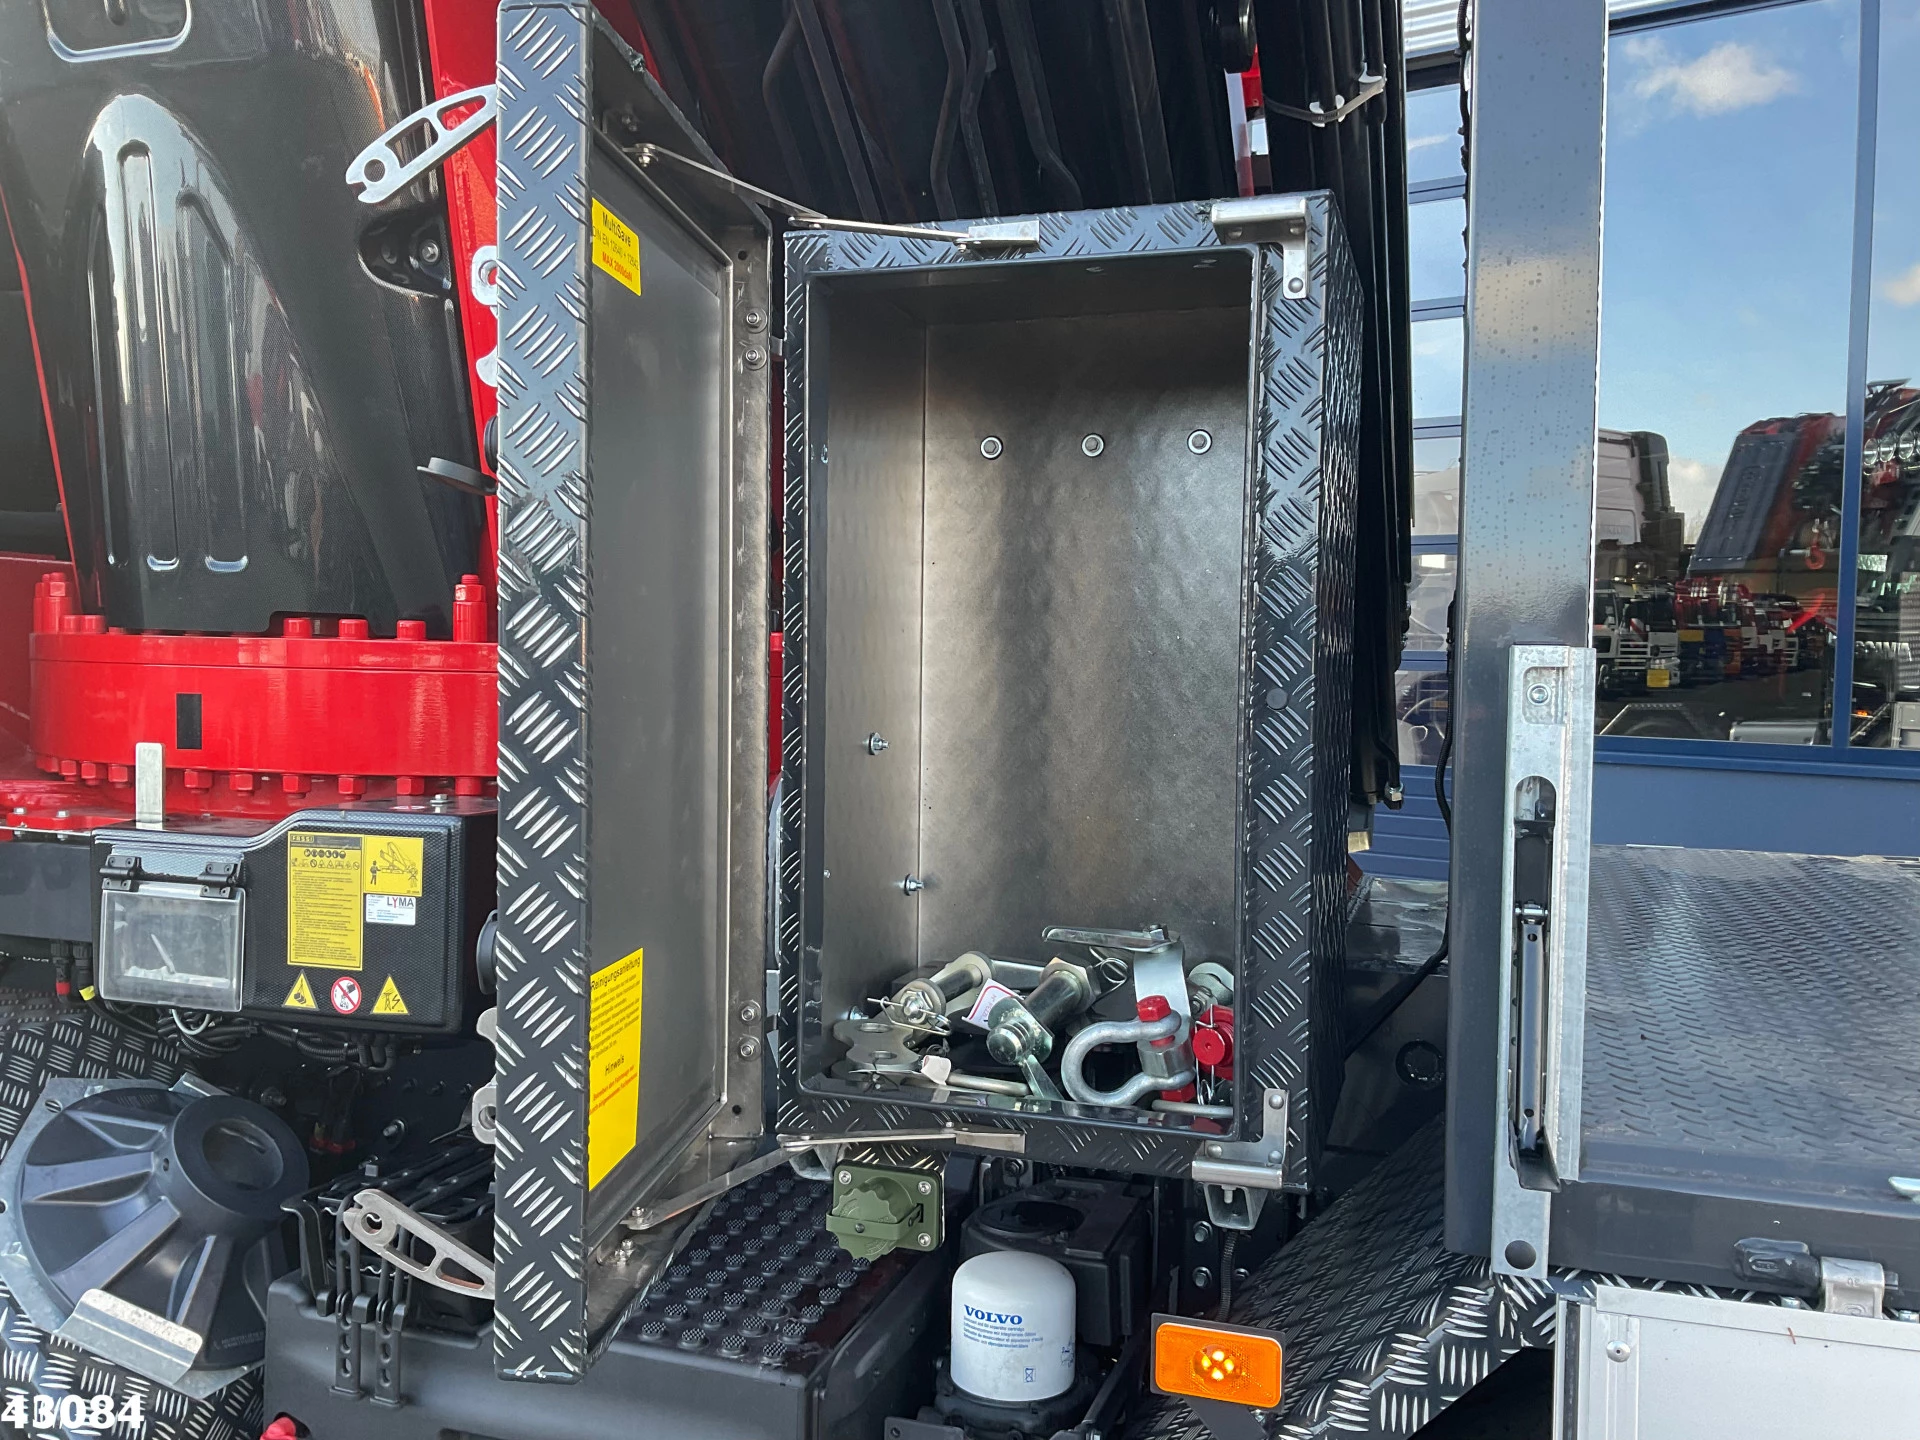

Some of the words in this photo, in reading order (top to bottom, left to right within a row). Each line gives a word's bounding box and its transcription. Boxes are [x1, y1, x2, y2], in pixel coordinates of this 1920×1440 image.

[602, 212, 631, 247] MultiSave
[387, 896, 415, 908] LYMA
[964, 1303, 1023, 1325] VOLVO
